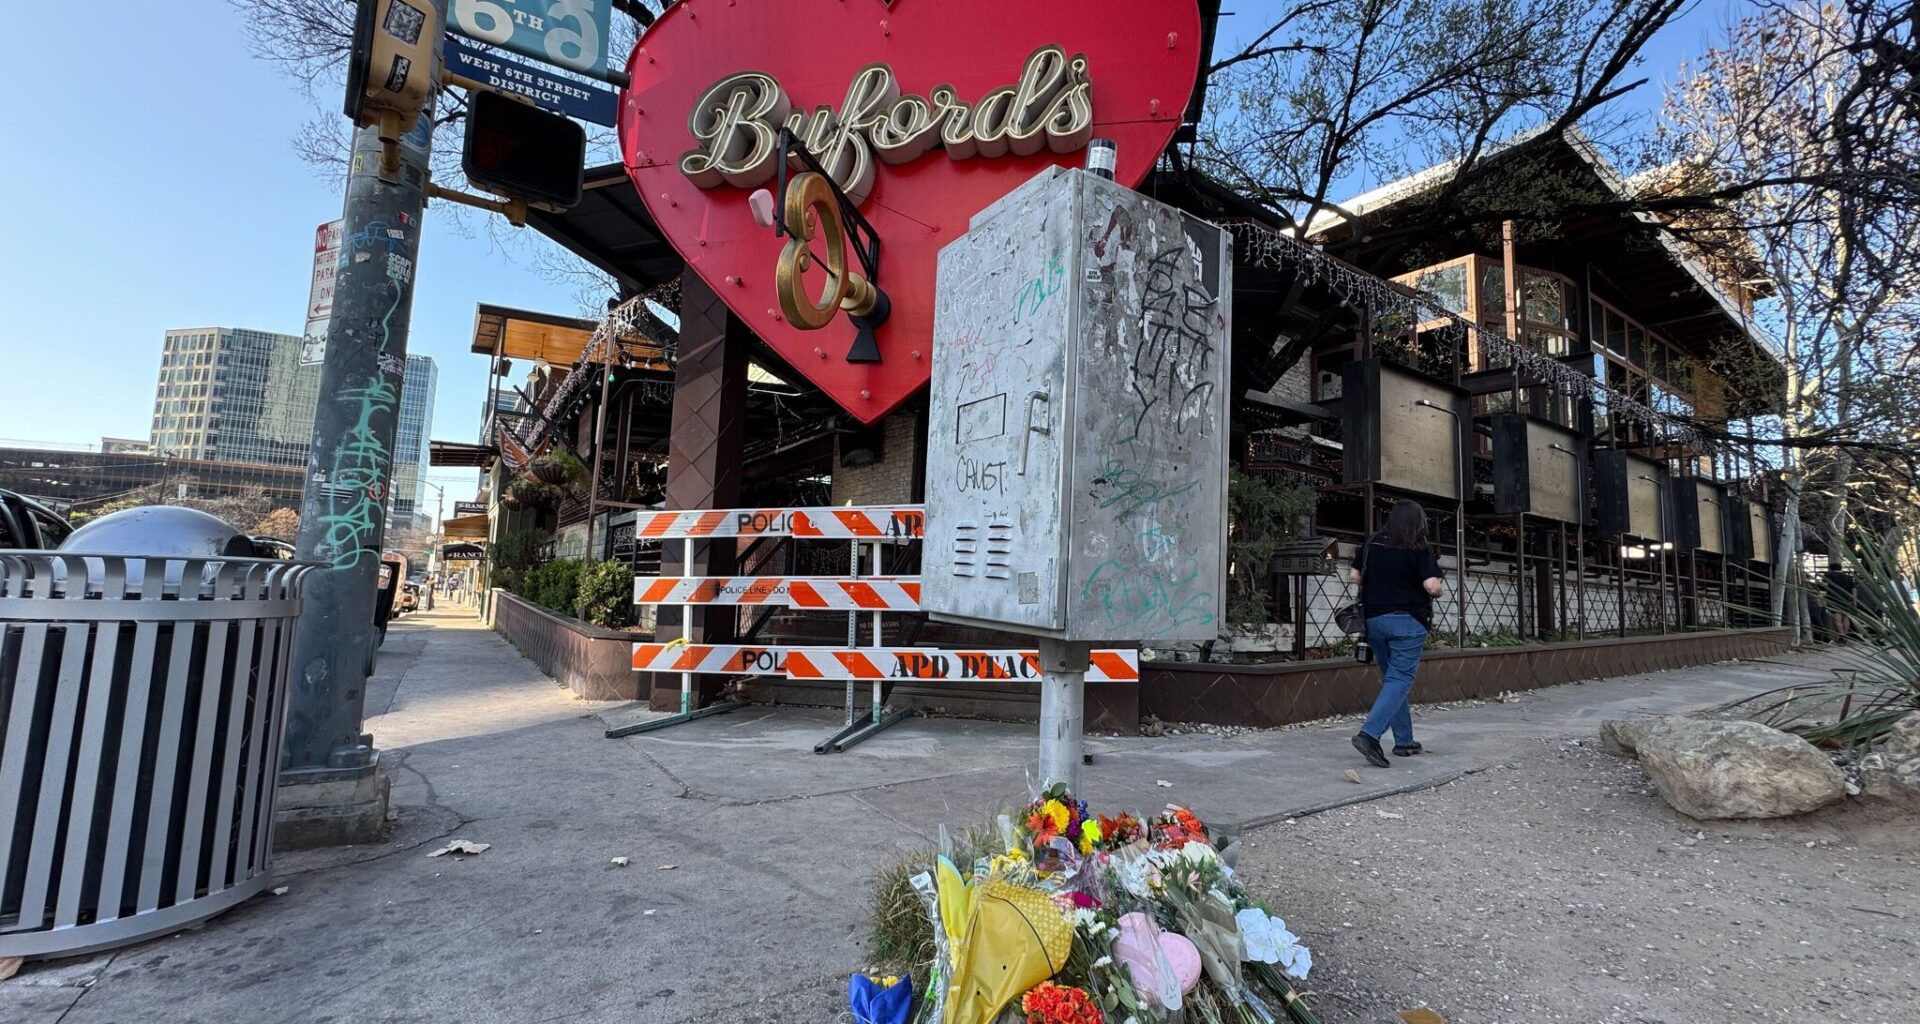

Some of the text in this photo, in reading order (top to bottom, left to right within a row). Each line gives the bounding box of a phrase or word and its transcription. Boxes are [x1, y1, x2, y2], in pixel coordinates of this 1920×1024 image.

[459, 53, 591, 101] WEST 6TH STREET
[489, 75, 561, 104] DISTRICT
[677, 43, 1093, 200] Buford's
[317, 228, 327, 249] NO
[720, 586, 747, 594] POLICE
[750, 586, 767, 594] LINE
[773, 586, 785, 594] DO
[890, 655, 1039, 680] APD DTAC
